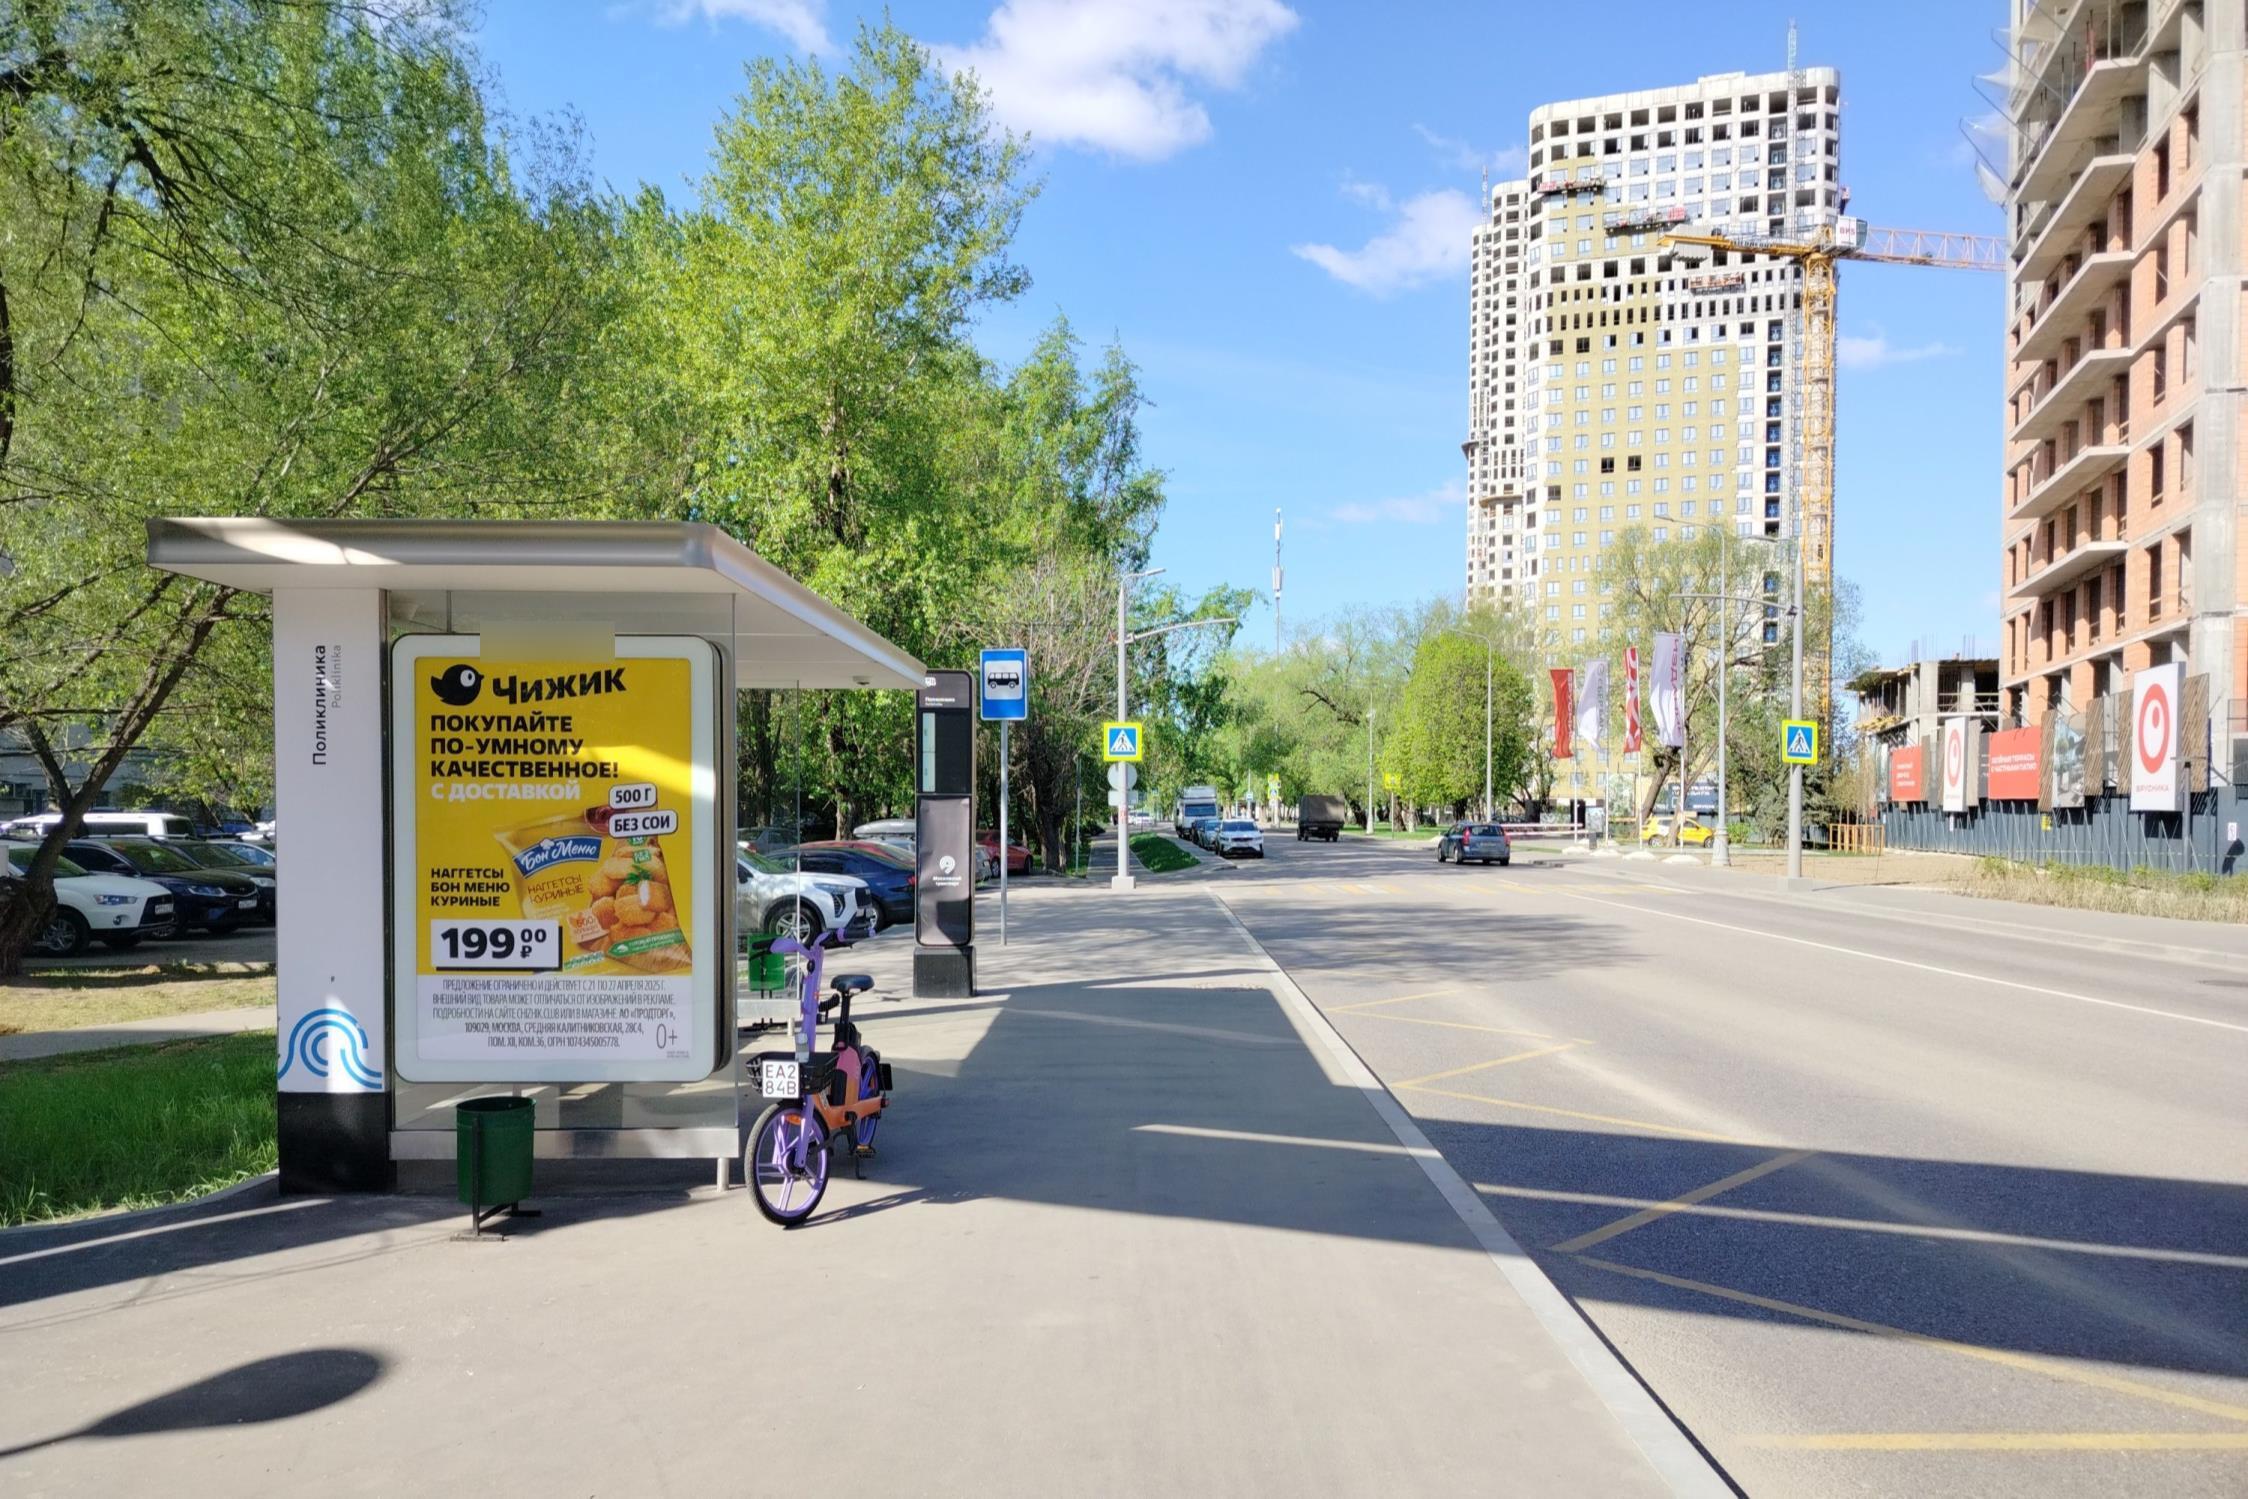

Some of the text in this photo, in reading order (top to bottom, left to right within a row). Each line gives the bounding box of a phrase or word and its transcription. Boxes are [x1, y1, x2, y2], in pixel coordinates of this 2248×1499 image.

[331, 644, 342, 708] Poliklinika
[312, 645, 327, 765] Поликлиника
[431, 710, 573, 733] ПОКУПАЙТЕ
[431, 738, 584, 756] ПО-УМНОМУ
[431, 761, 619, 779] КАЧЕСТВЕННОЕ!
[431, 780, 581, 802] С ДОСТАВКОЙ
[615, 787, 652, 804] 500 Г
[614, 815, 670, 833] БЕЗ СОИ
[520, 840, 597, 870] Бон Меню
[431, 868, 504, 879] НАГГЕТСЫ
[431, 882, 510, 893] БОН МЕНЮ
[527, 873, 582, 895] НАГГЕТСЫ
[431, 895, 501, 907] КУРИНЫЕ
[530, 885, 585, 905] КУРИНЫЕ
[440, 927, 515, 959] 199
[520, 928, 547, 943] 00
[443, 980, 492, 991] ПРЕДЛОЖЕНИЕ
[493, 980, 537, 991] ОГРАНИЧЕНО
[544, 977, 581, 991] ДЕЙСТВУЕТ
[617, 980, 644, 991] АПРЕЛЯ
[433, 991, 466, 1005] ВНЕШНИЙ
[483, 994, 507, 1005] ТОВАРА
[508, 994, 533, 1005] МОЖЕТ
[534, 994, 576, 1005] ОТЛИЧАТЬСЯ
[586, 991, 637, 1005] ИЗОБРАЖЕНИЙ
[433, 1008, 484, 1019] ПОДРОБНОСТИ
[524, 1023, 556, 1034] СРЕДНЯЯ
[656, 1023, 678, 1049] 0+
